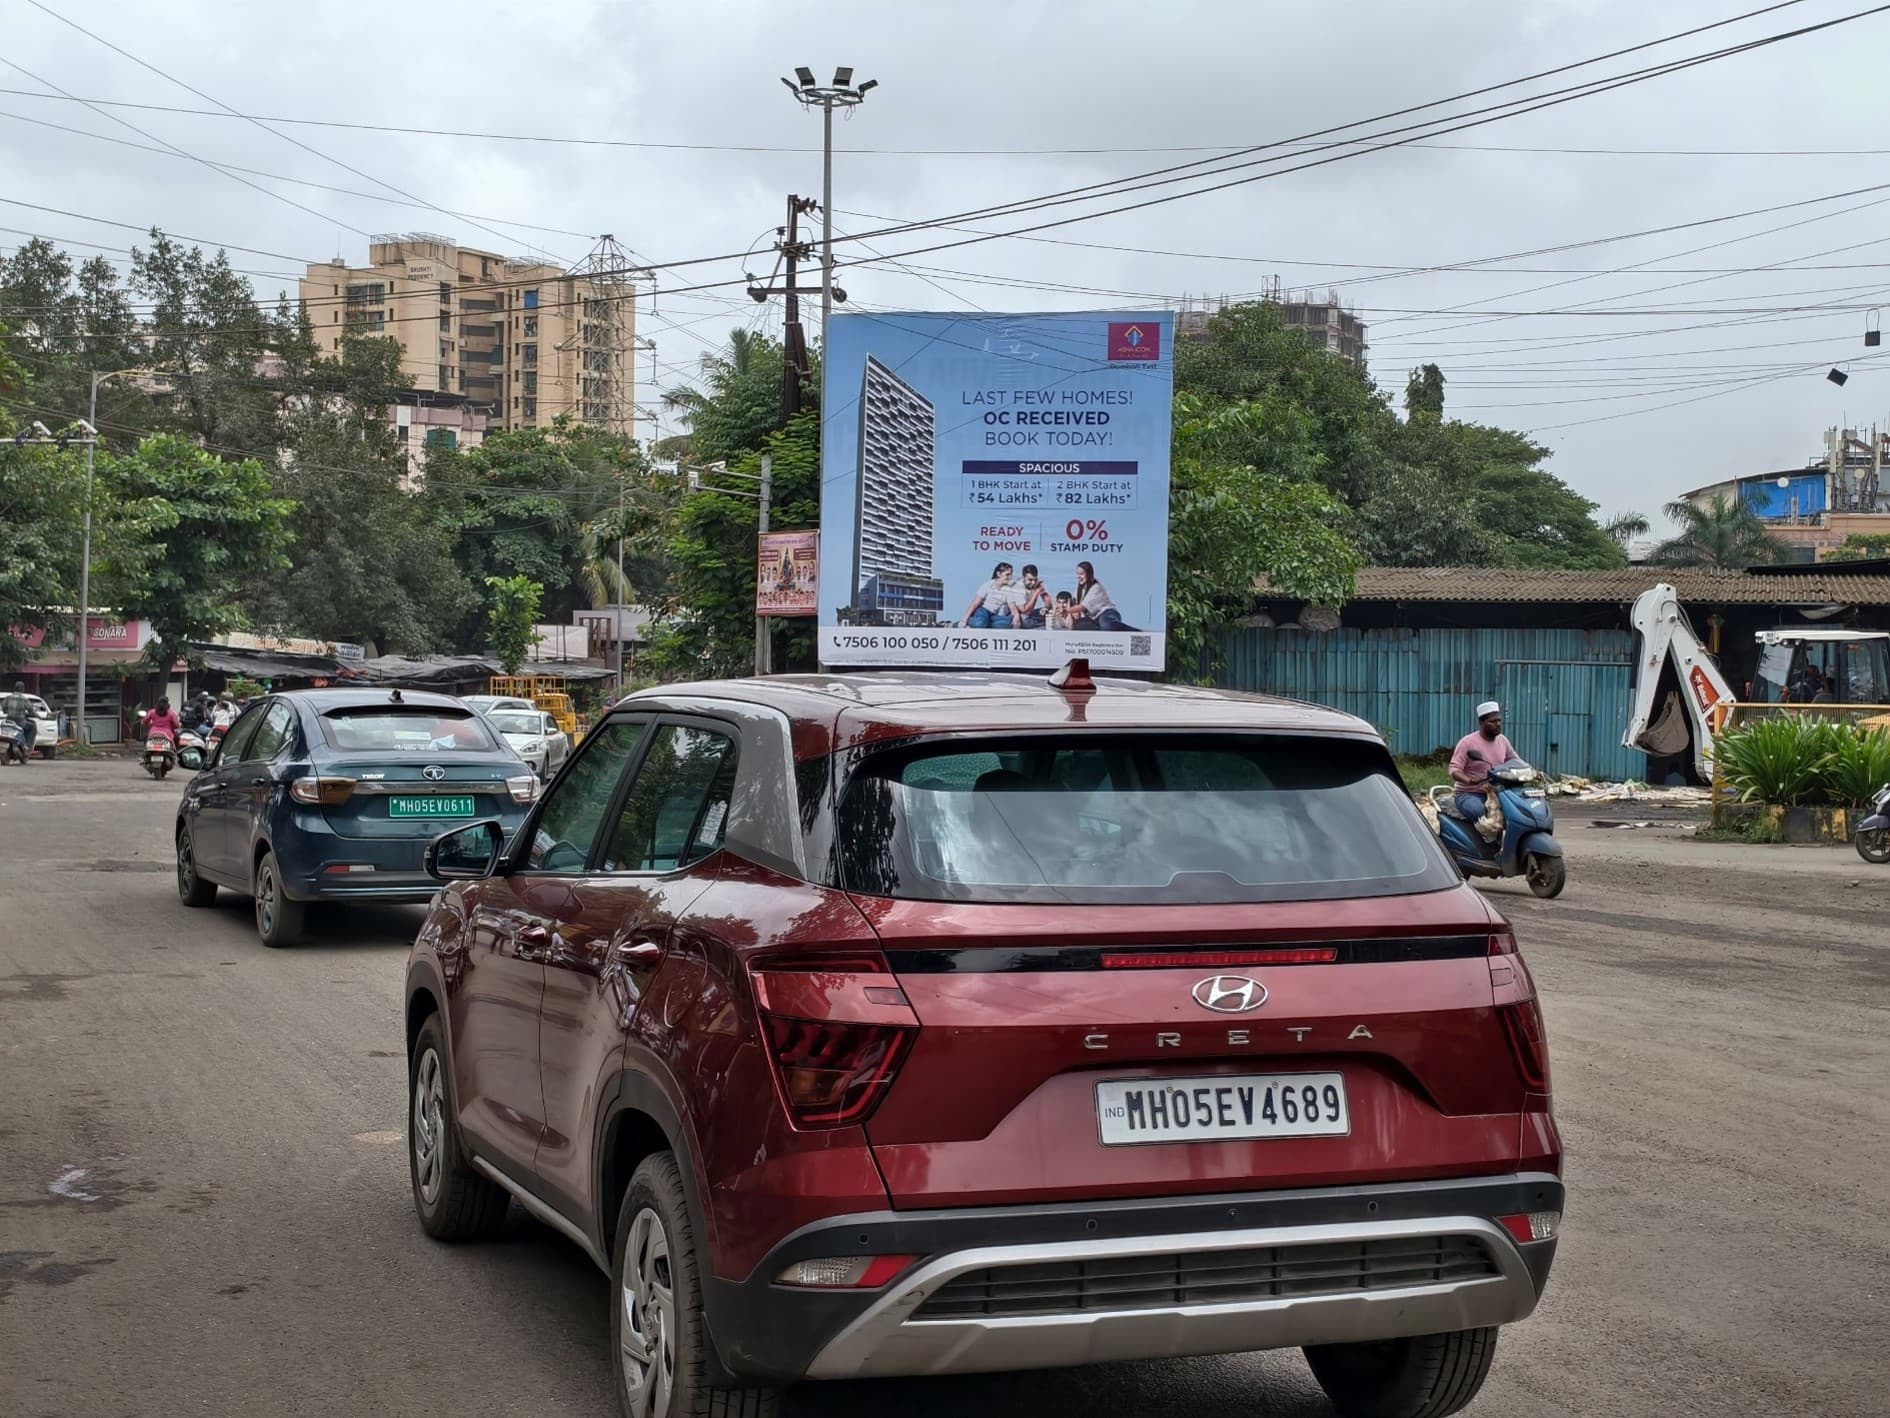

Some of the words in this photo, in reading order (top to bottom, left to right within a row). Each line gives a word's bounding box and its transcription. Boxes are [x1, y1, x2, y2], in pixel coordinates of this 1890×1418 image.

[962, 390, 1007, 405] LAST
[1013, 391, 1055, 405] FEW
[1062, 390, 1133, 405] HOMES!
[983, 411, 1010, 425] OC
[1016, 411, 1110, 425] RECEIVED
[985, 431, 1039, 446] BOOK
[1045, 431, 1113, 446] TODAY!
[1019, 462, 1080, 473] SPACIOUS
[978, 480, 1000, 489] BHK
[1003, 480, 1028, 489] Start
[1030, 480, 1042, 489] at
[1057, 480, 1063, 489] 2
[1066, 480, 1089, 489] BHK
[1091, 481, 1118, 490] Start
[1120, 481, 1131, 490] at
[980, 526, 1024, 537] READY
[1065, 518, 1108, 541] 0%
[973, 541, 989, 551] TO
[994, 541, 1031, 551] MOVE
[1049, 542, 1089, 552] STAMP
[1091, 543, 1124, 553] DUTY
[843, 636, 879, 649] 7506
[882, 636, 907, 649] 100
[911, 637, 939, 649] 050
[952, 638, 989, 650] 7506
[992, 638, 1009, 650] 111
[1013, 639, 1037, 651] 201
[399, 799, 472, 813] MH05EV0611
[1084, 1024, 1373, 1049] CRETA
[1104, 1106, 1125, 1119] IND
[1125, 1084, 1341, 1131] MH05EV4689
